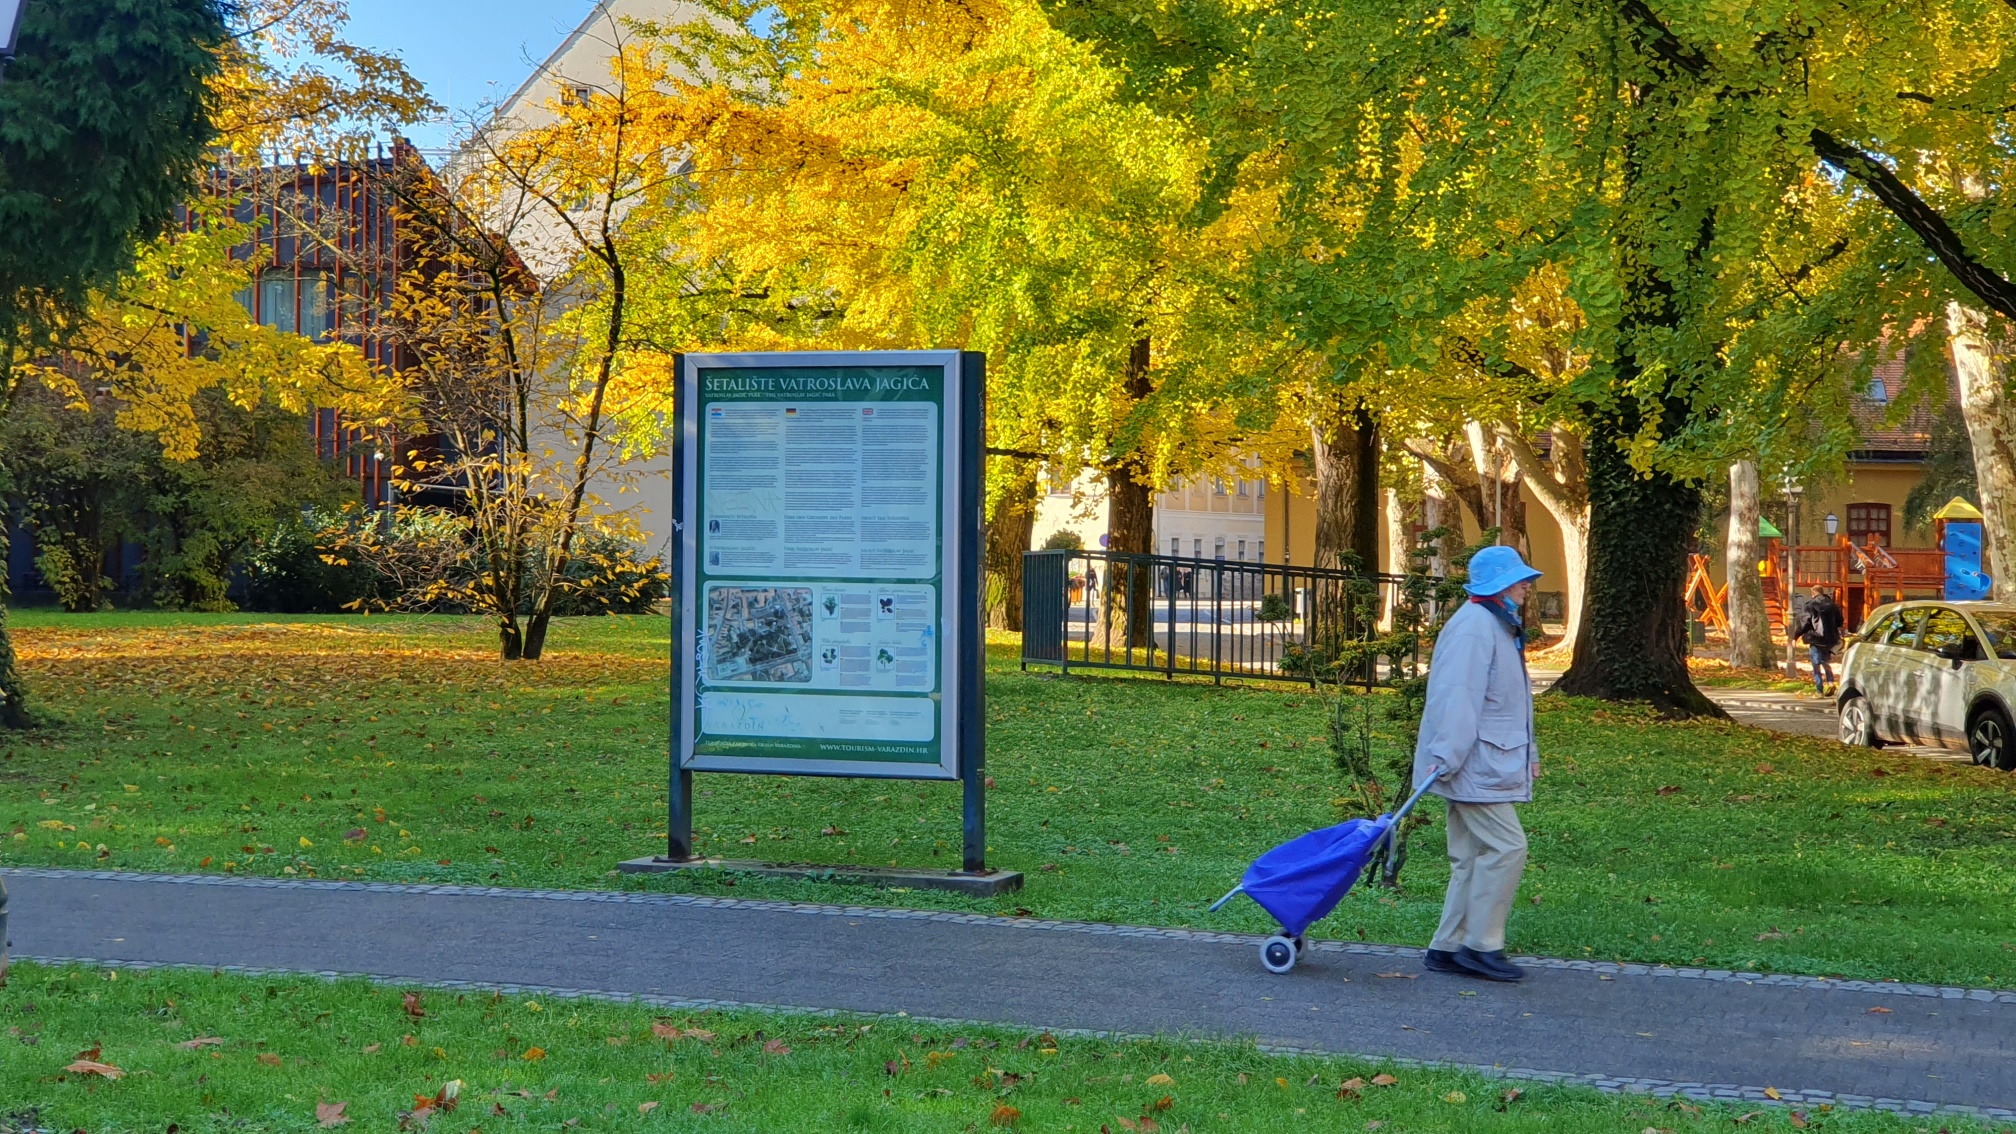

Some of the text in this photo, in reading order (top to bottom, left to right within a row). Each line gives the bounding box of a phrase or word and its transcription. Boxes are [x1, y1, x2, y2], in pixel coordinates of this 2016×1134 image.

[705, 374, 930, 392] ŠETALIŠTE VATROSLAVA JAGIĆA
[819, 743, 929, 754] WWW.TOURISM-VARAZDIN.HR
